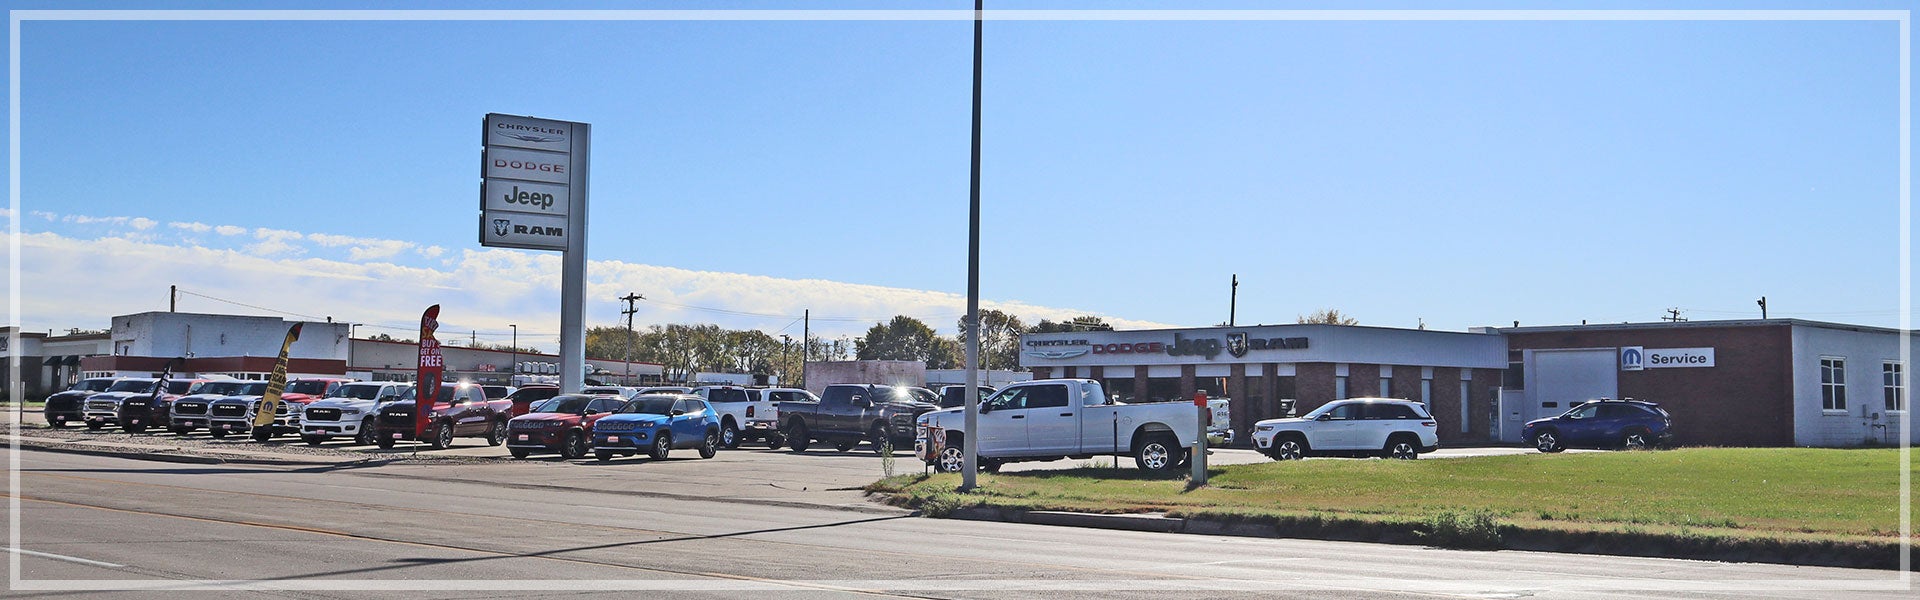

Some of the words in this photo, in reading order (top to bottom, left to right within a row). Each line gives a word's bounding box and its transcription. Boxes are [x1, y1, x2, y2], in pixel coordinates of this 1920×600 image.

[497, 122, 564, 135] CHRYSLER
[494, 159, 564, 173] DODGE
[504, 185, 554, 210] Jeep
[514, 224, 563, 237] RAM
[422, 339, 436, 348] BUY
[1026, 339, 1089, 347] CHRYSLER
[1092, 342, 1162, 355] DODGE
[1166, 332, 1221, 360] Jeep
[1250, 336, 1309, 350] RAM
[420, 355, 442, 367] FREE
[1651, 353, 1707, 364] Service
